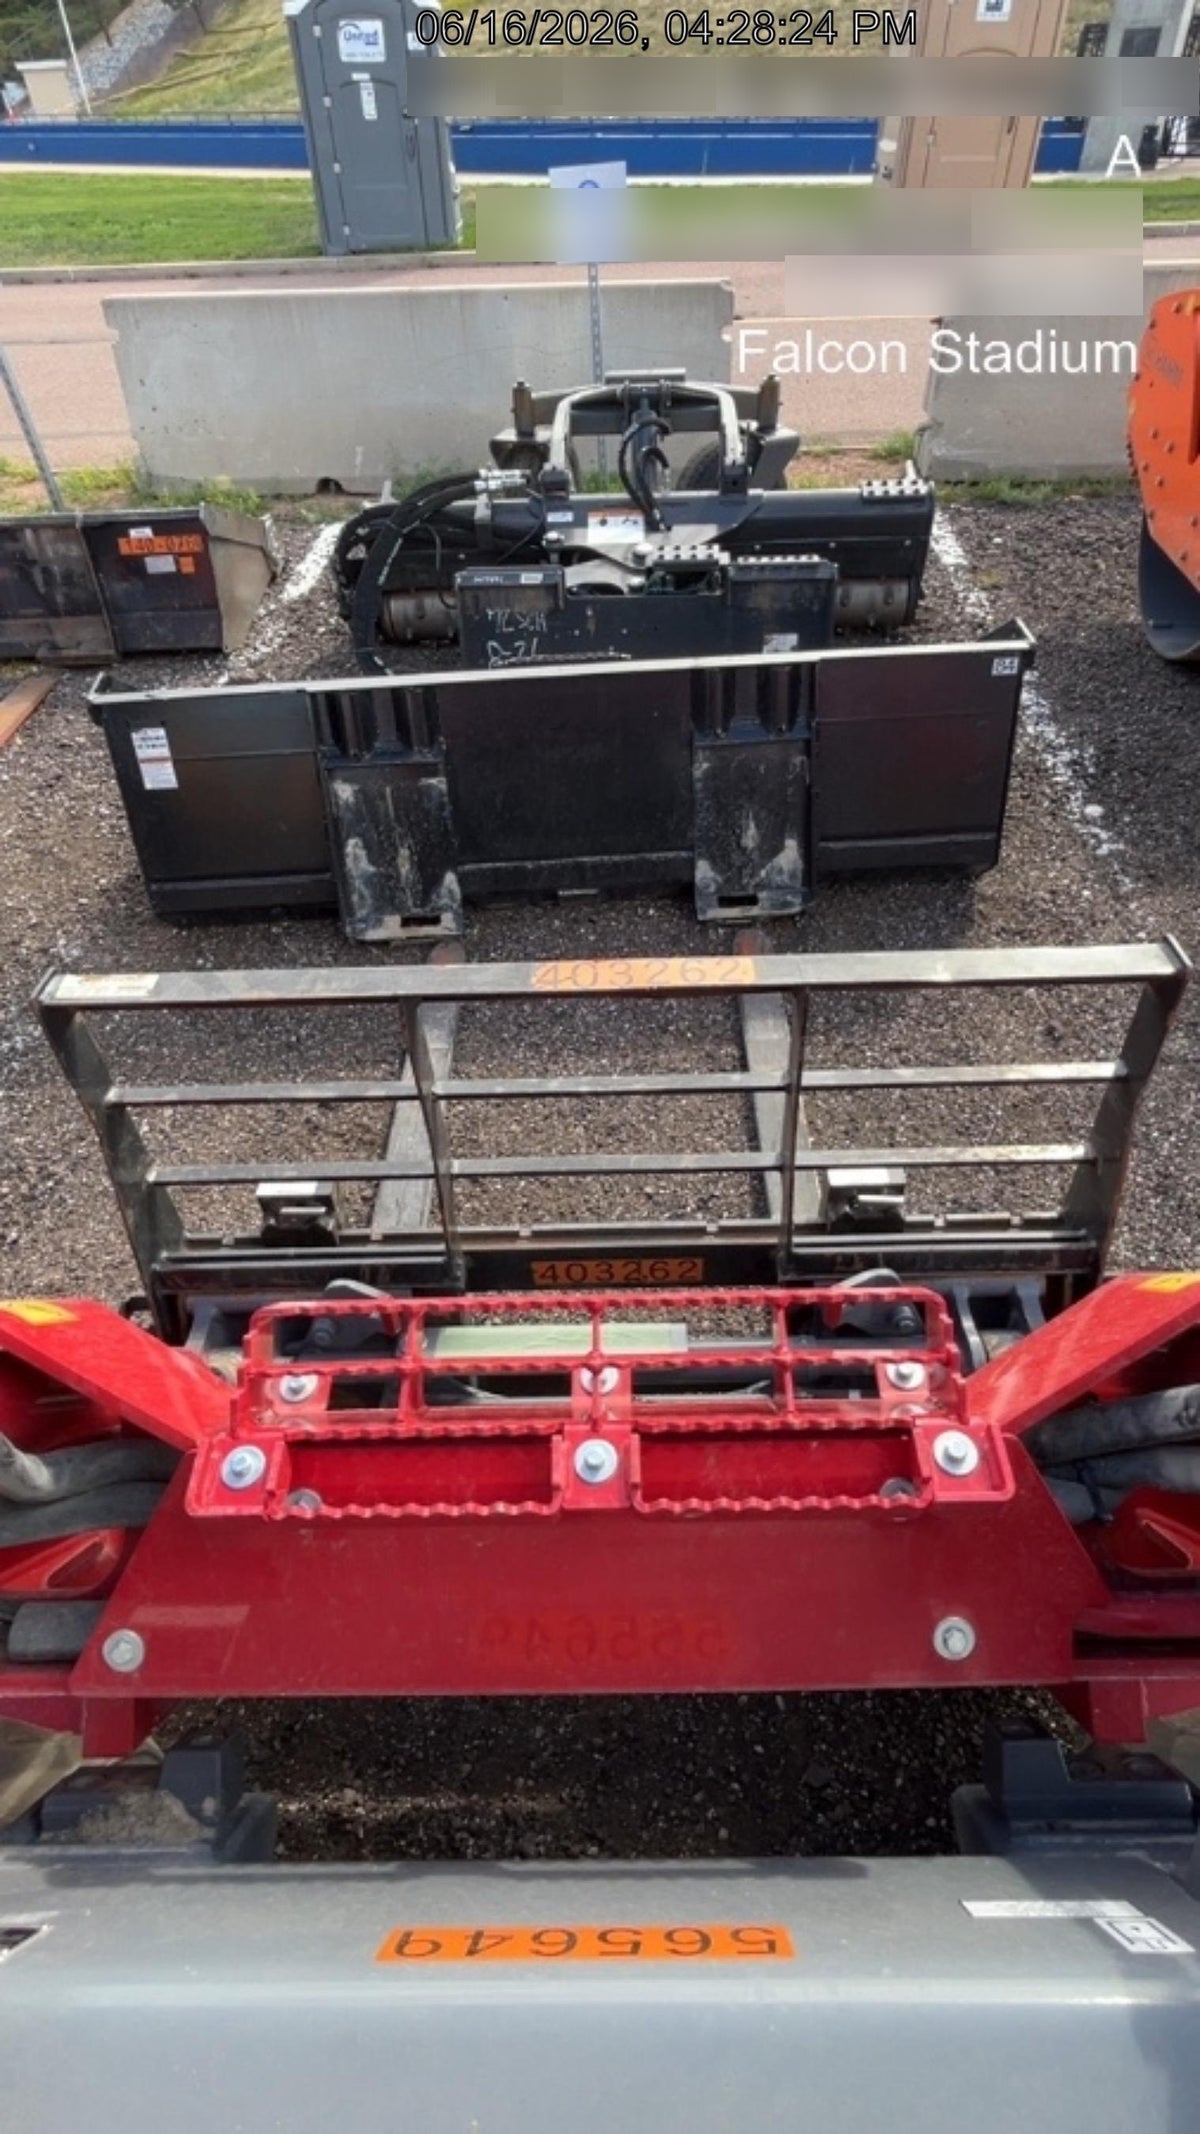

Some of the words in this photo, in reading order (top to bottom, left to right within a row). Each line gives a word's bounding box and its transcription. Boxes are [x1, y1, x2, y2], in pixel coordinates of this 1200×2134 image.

[535, 959, 742, 989] 403262
[539, 1260, 698, 1283] 403262
[394, 1927, 777, 1958] 565649
